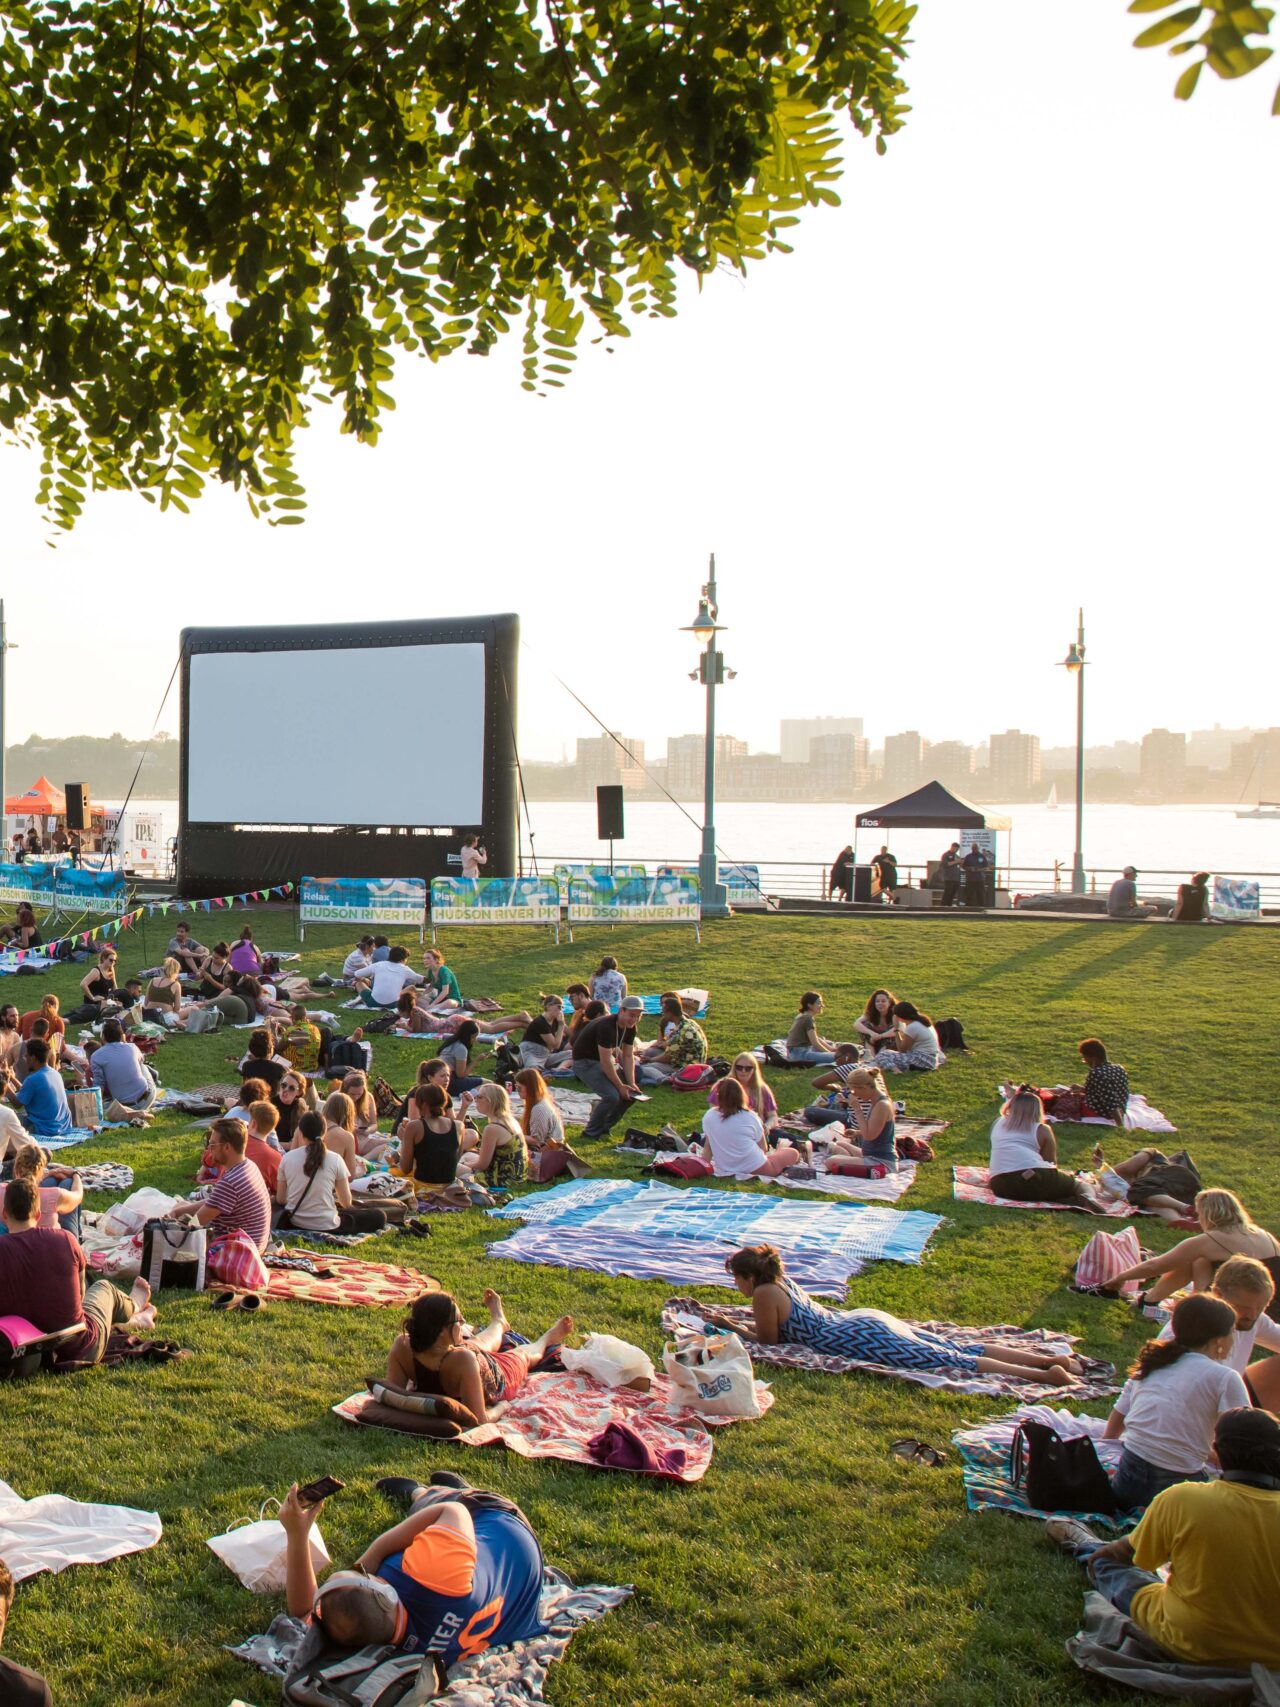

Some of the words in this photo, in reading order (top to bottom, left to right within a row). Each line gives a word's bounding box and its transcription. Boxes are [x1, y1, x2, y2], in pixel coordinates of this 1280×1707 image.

[861, 818, 879, 827] fios
[135, 823, 153, 842] IPA
[303, 892, 330, 902] Relax
[434, 892, 456, 903] Play
[571, 889, 593, 901] Play
[303, 906, 358, 919] HUDSON
[361, 908, 400, 920] RIVER
[403, 910, 421, 921] PK
[435, 909, 491, 920] HUDSON
[495, 908, 534, 919] RIVER
[538, 907, 557, 918] PK
[571, 906, 630, 918] HUDSON
[633, 907, 673, 918] RIVER
[677, 906, 697, 917] PK
[10, 1344, 27, 1360] XR
